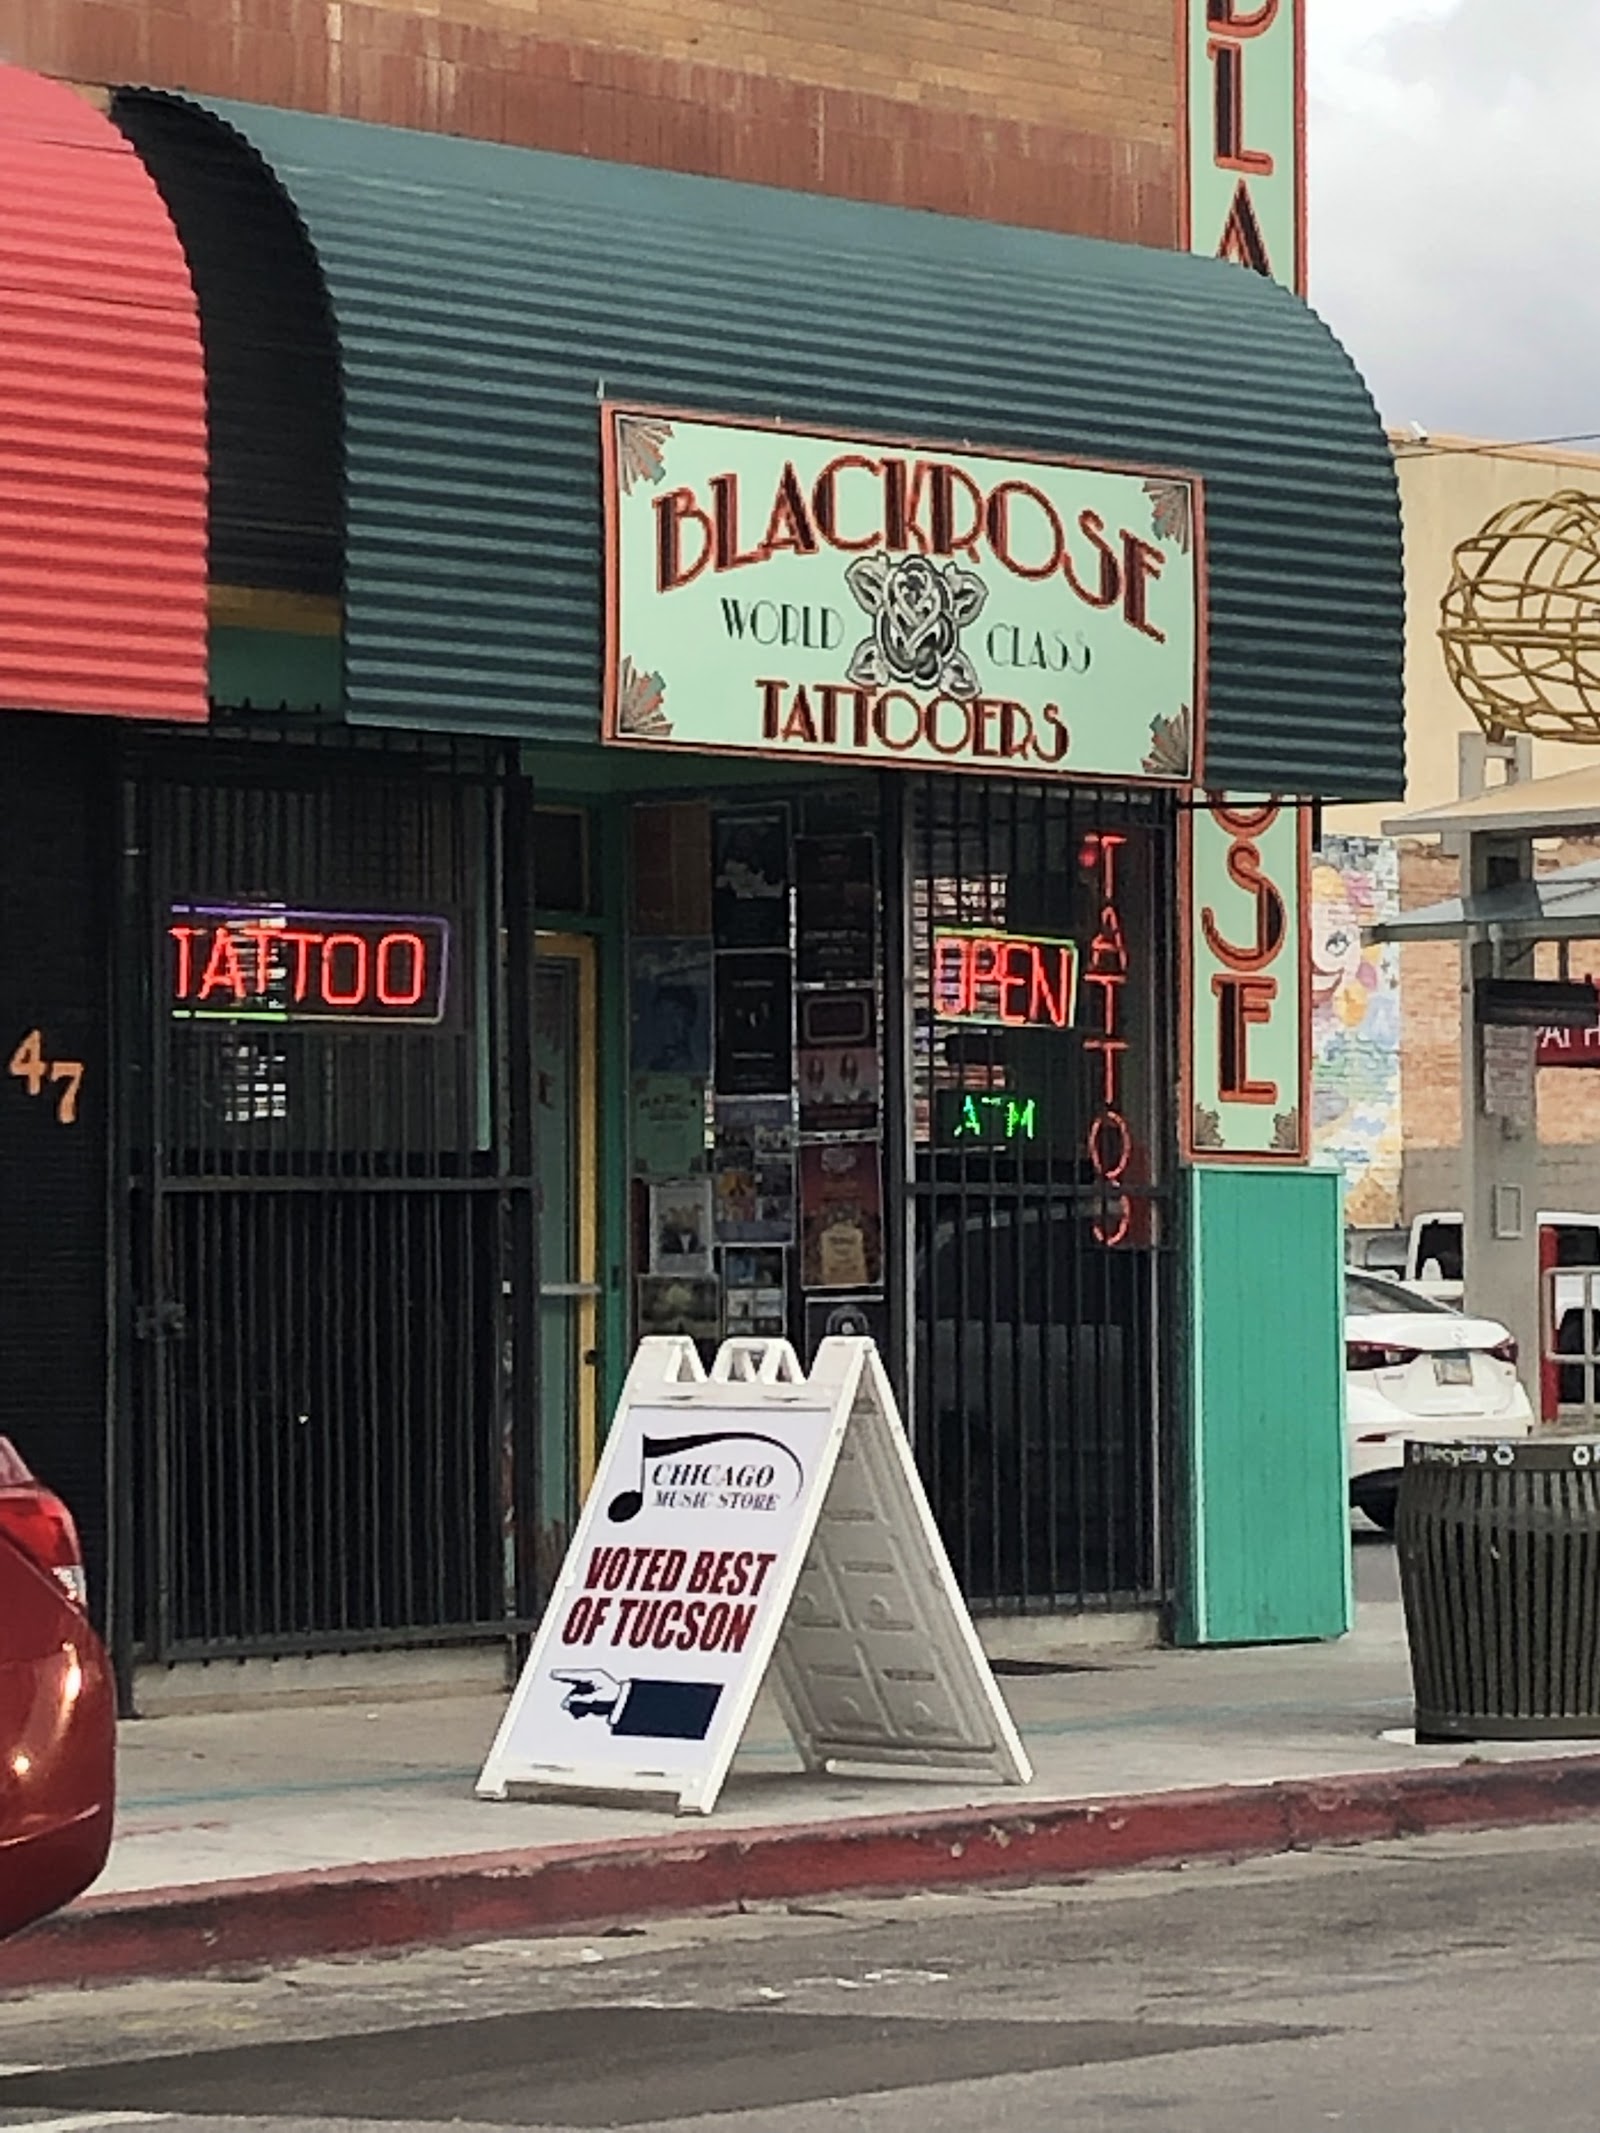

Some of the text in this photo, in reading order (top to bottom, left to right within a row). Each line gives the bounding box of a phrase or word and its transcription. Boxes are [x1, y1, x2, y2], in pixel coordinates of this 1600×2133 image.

[720, 597, 1091, 673] WORLD CLASS
[755, 679, 1069, 763] TATTOOERS
[168, 926, 425, 1006] TATTOO
[934, 937, 1068, 1027] OPEN
[8, 1028, 84, 1124] 47
[652, 1464, 776, 1488] CHICAGO
[652, 1490, 781, 1512] MUSIC STORE
[583, 1547, 777, 1597] VOTED BEST
[561, 1596, 758, 1654] OF TUCSON
